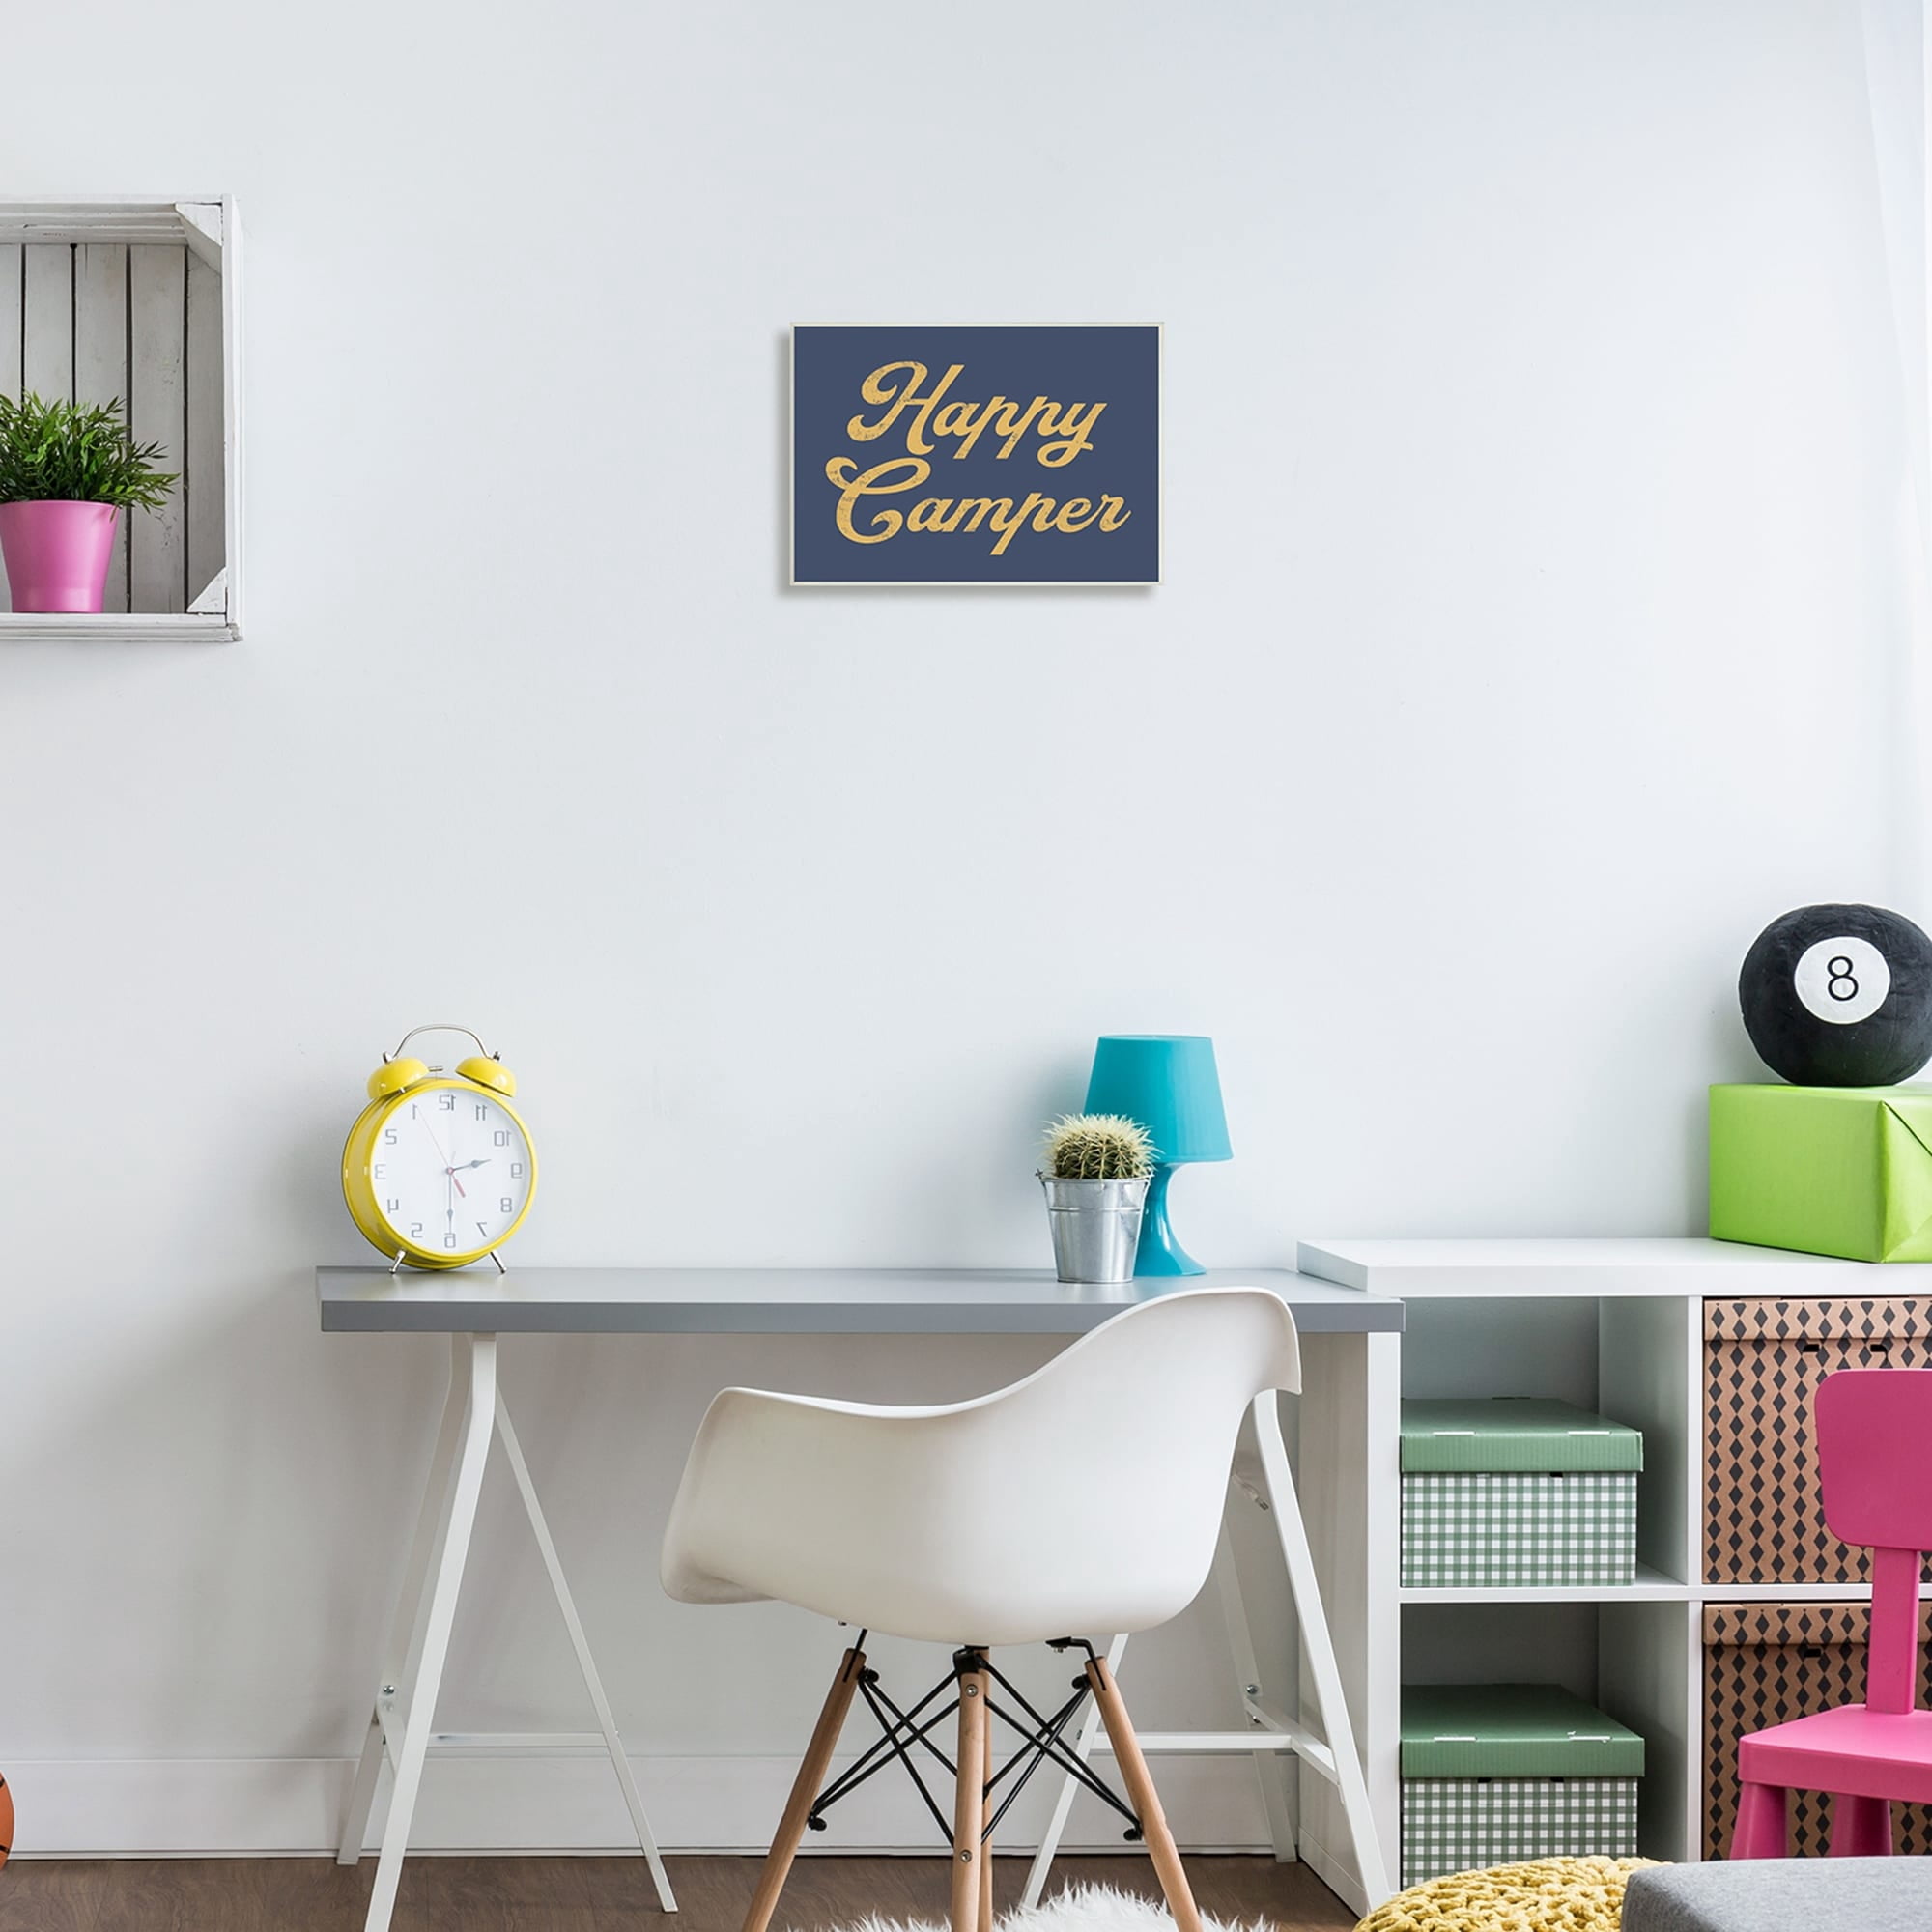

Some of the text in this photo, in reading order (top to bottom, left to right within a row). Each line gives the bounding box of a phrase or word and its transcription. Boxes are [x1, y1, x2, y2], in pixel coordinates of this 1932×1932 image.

[846, 360, 1108, 469] Happy
[824, 456, 1132, 556] Camper
[1827, 955, 1859, 1002] 8
